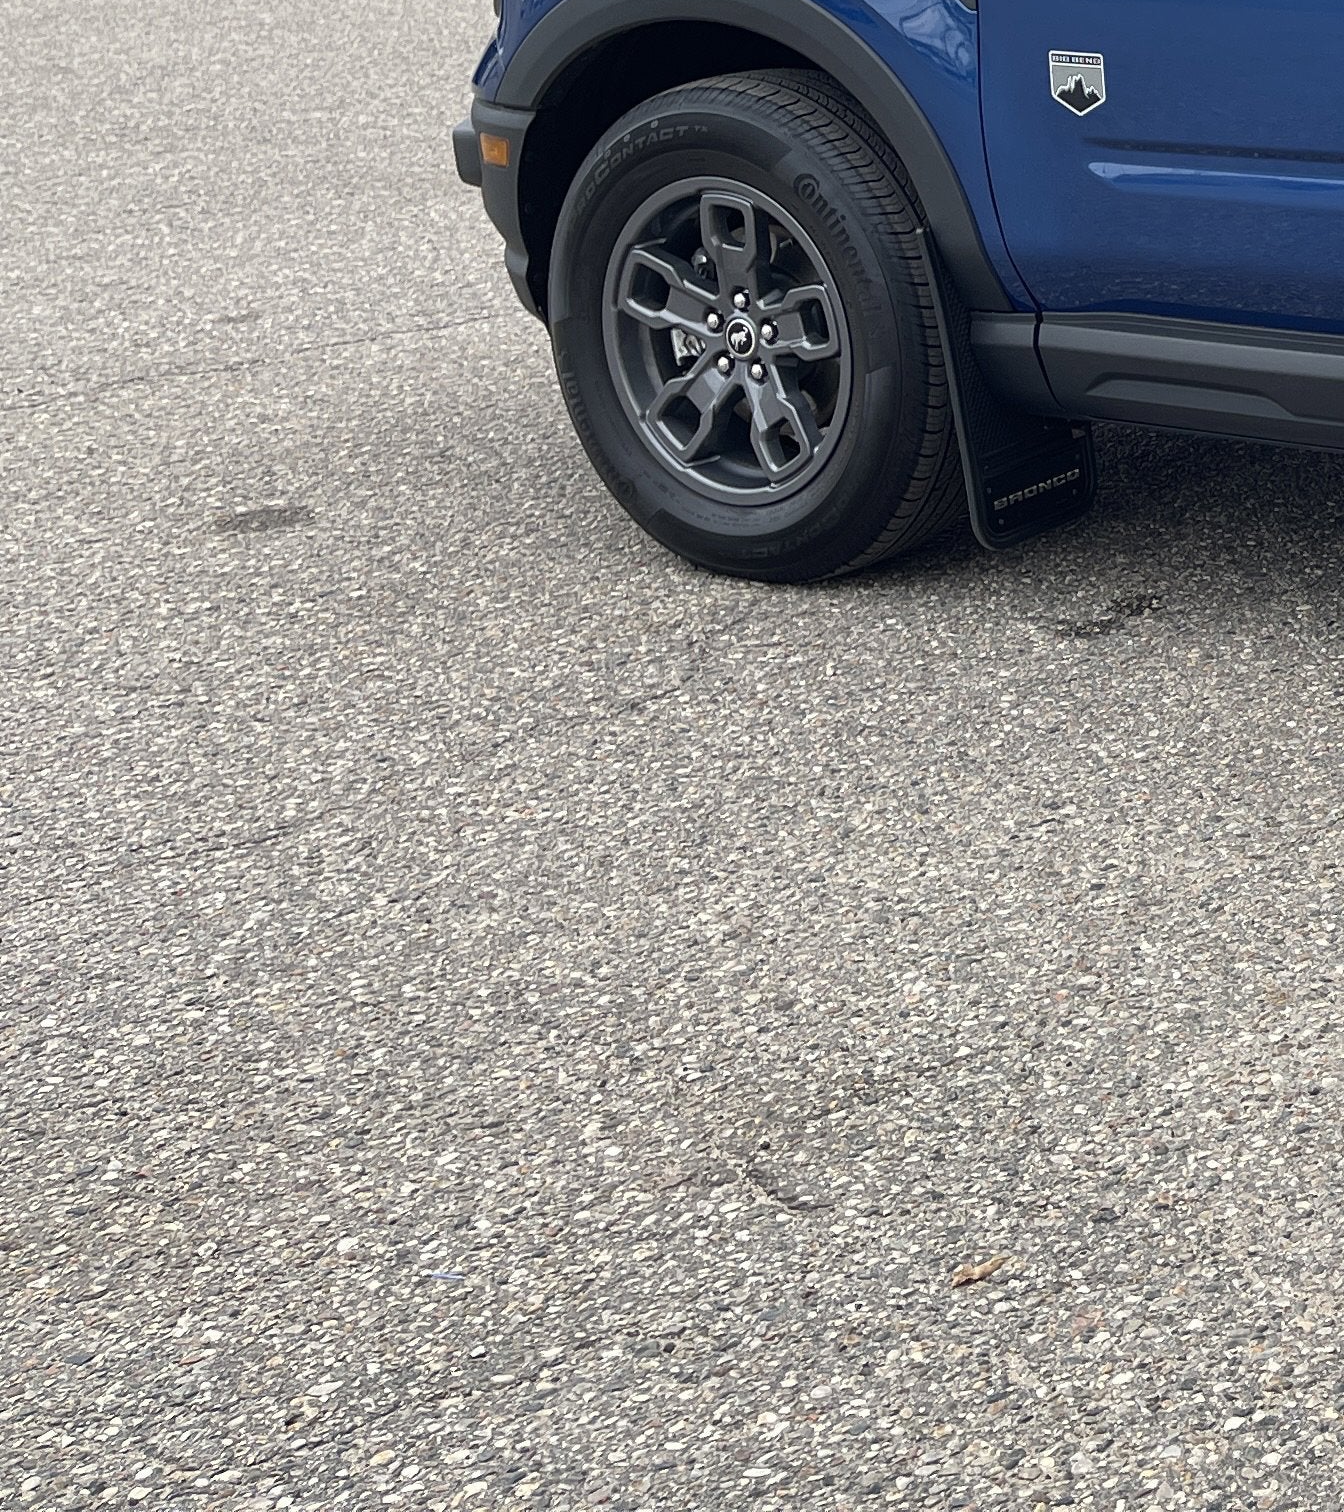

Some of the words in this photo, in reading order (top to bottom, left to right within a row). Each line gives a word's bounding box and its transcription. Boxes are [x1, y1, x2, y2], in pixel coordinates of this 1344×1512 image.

[1052, 55, 1069, 63] BIG
[793, 173, 882, 312] Continental
[993, 468, 1080, 511] BRONCO
